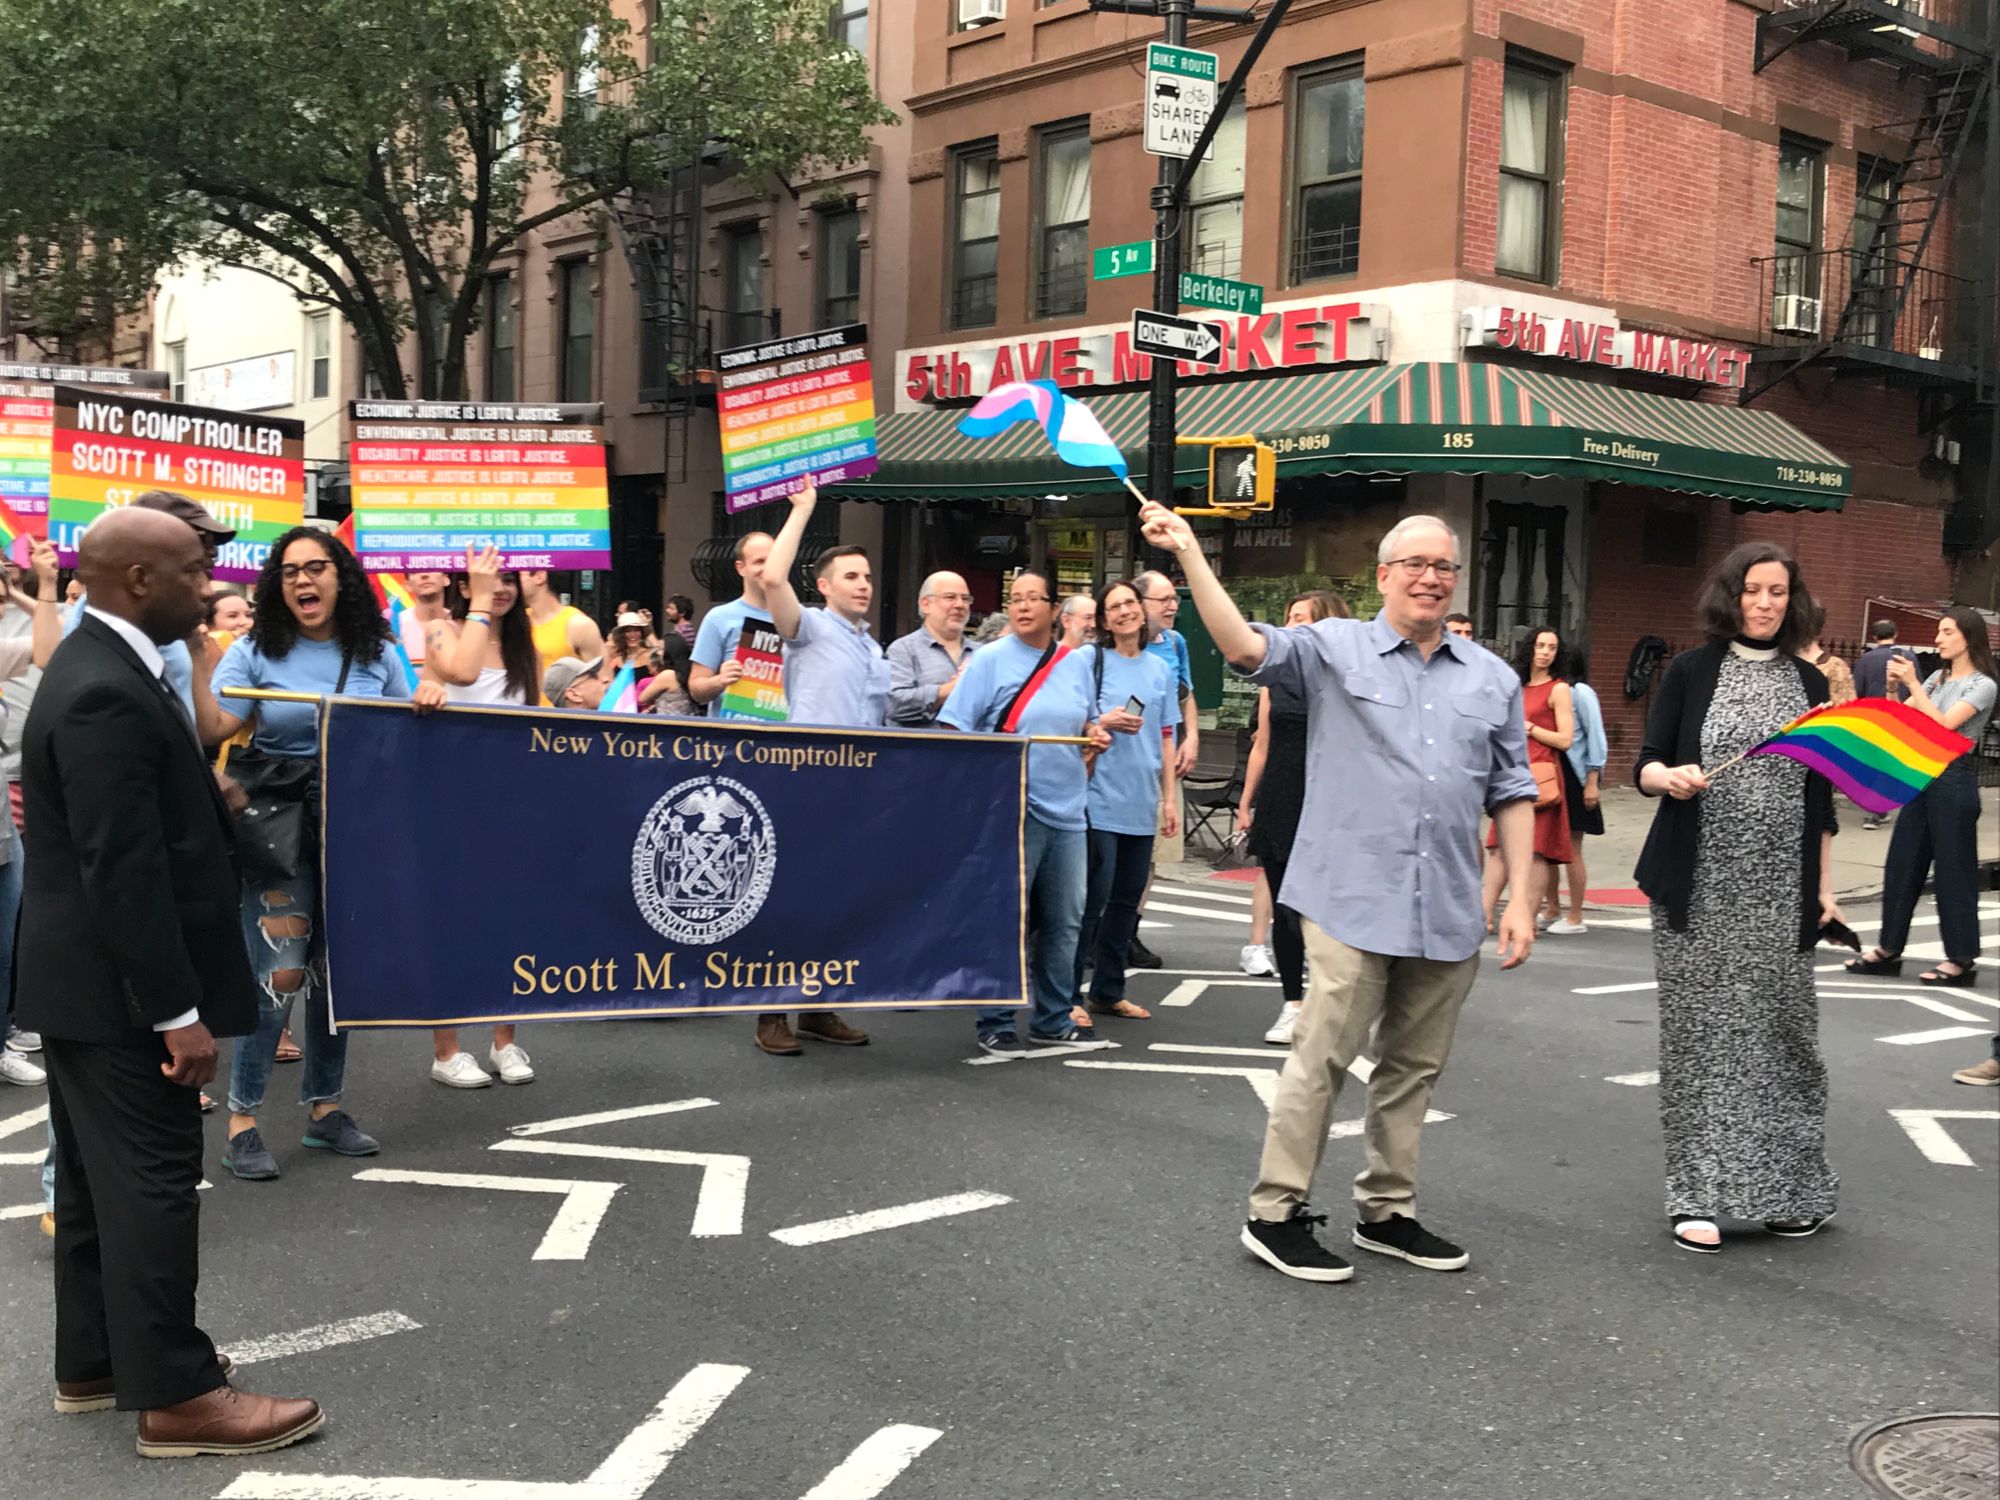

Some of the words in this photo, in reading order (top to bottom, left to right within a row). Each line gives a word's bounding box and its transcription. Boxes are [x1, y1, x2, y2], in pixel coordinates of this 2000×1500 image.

[1152, 52, 1176, 68] BIKE
[1181, 57, 1214, 75] ROUTE
[1152, 102, 1210, 126] SHARED
[1111, 250, 1120, 274] 5
[1182, 276, 1246, 312] Berkeley
[1141, 324, 1169, 344] ONE
[1184, 331, 1212, 350] WAY
[1496, 307, 1546, 353] 5th
[1557, 318, 1623, 368] AVE.
[1632, 331, 1751, 388] MARKET
[906, 351, 973, 401] 5th
[989, 337, 1094, 393] AVE.
[356, 404, 413, 418] ECONOMIC
[415, 405, 461, 420] JUSTICE
[462, 406, 475, 420] IS
[477, 407, 513, 421] LGBTQ
[78, 401, 125, 435] NYC
[132, 409, 283, 456] COMPTROLLER
[450, 427, 496, 441] JUSTICE
[497, 428, 510, 441] IS
[511, 429, 547, 442] LGBTQ
[1442, 433, 1474, 448] 185
[422, 449, 467, 462] JUSTICE
[469, 450, 482, 462] IS
[484, 450, 520, 463] LGBTQ
[1583, 437, 1609, 454] Free
[1612, 442, 1660, 466] Delivery
[72, 442, 147, 478] SCOTT
[154, 452, 177, 482] M.
[184, 457, 286, 495] STRINGER
[432, 470, 477, 483] JUSTICE
[479, 471, 491, 484] IS
[1776, 466, 1842, 487] 718-230-8050
[362, 556, 404, 569] RACIAL
[406, 556, 453, 569] JUSTICE
[751, 630, 780, 653] NYC
[529, 727, 592, 754] New
[602, 731, 664, 759] York
[673, 735, 727, 768] City
[735, 739, 877, 771] Comptroller
[686, 908, 715, 919] 1625
[512, 954, 618, 995] Scott
[634, 953, 687, 990] M.
[704, 950, 860, 997] Stringer
